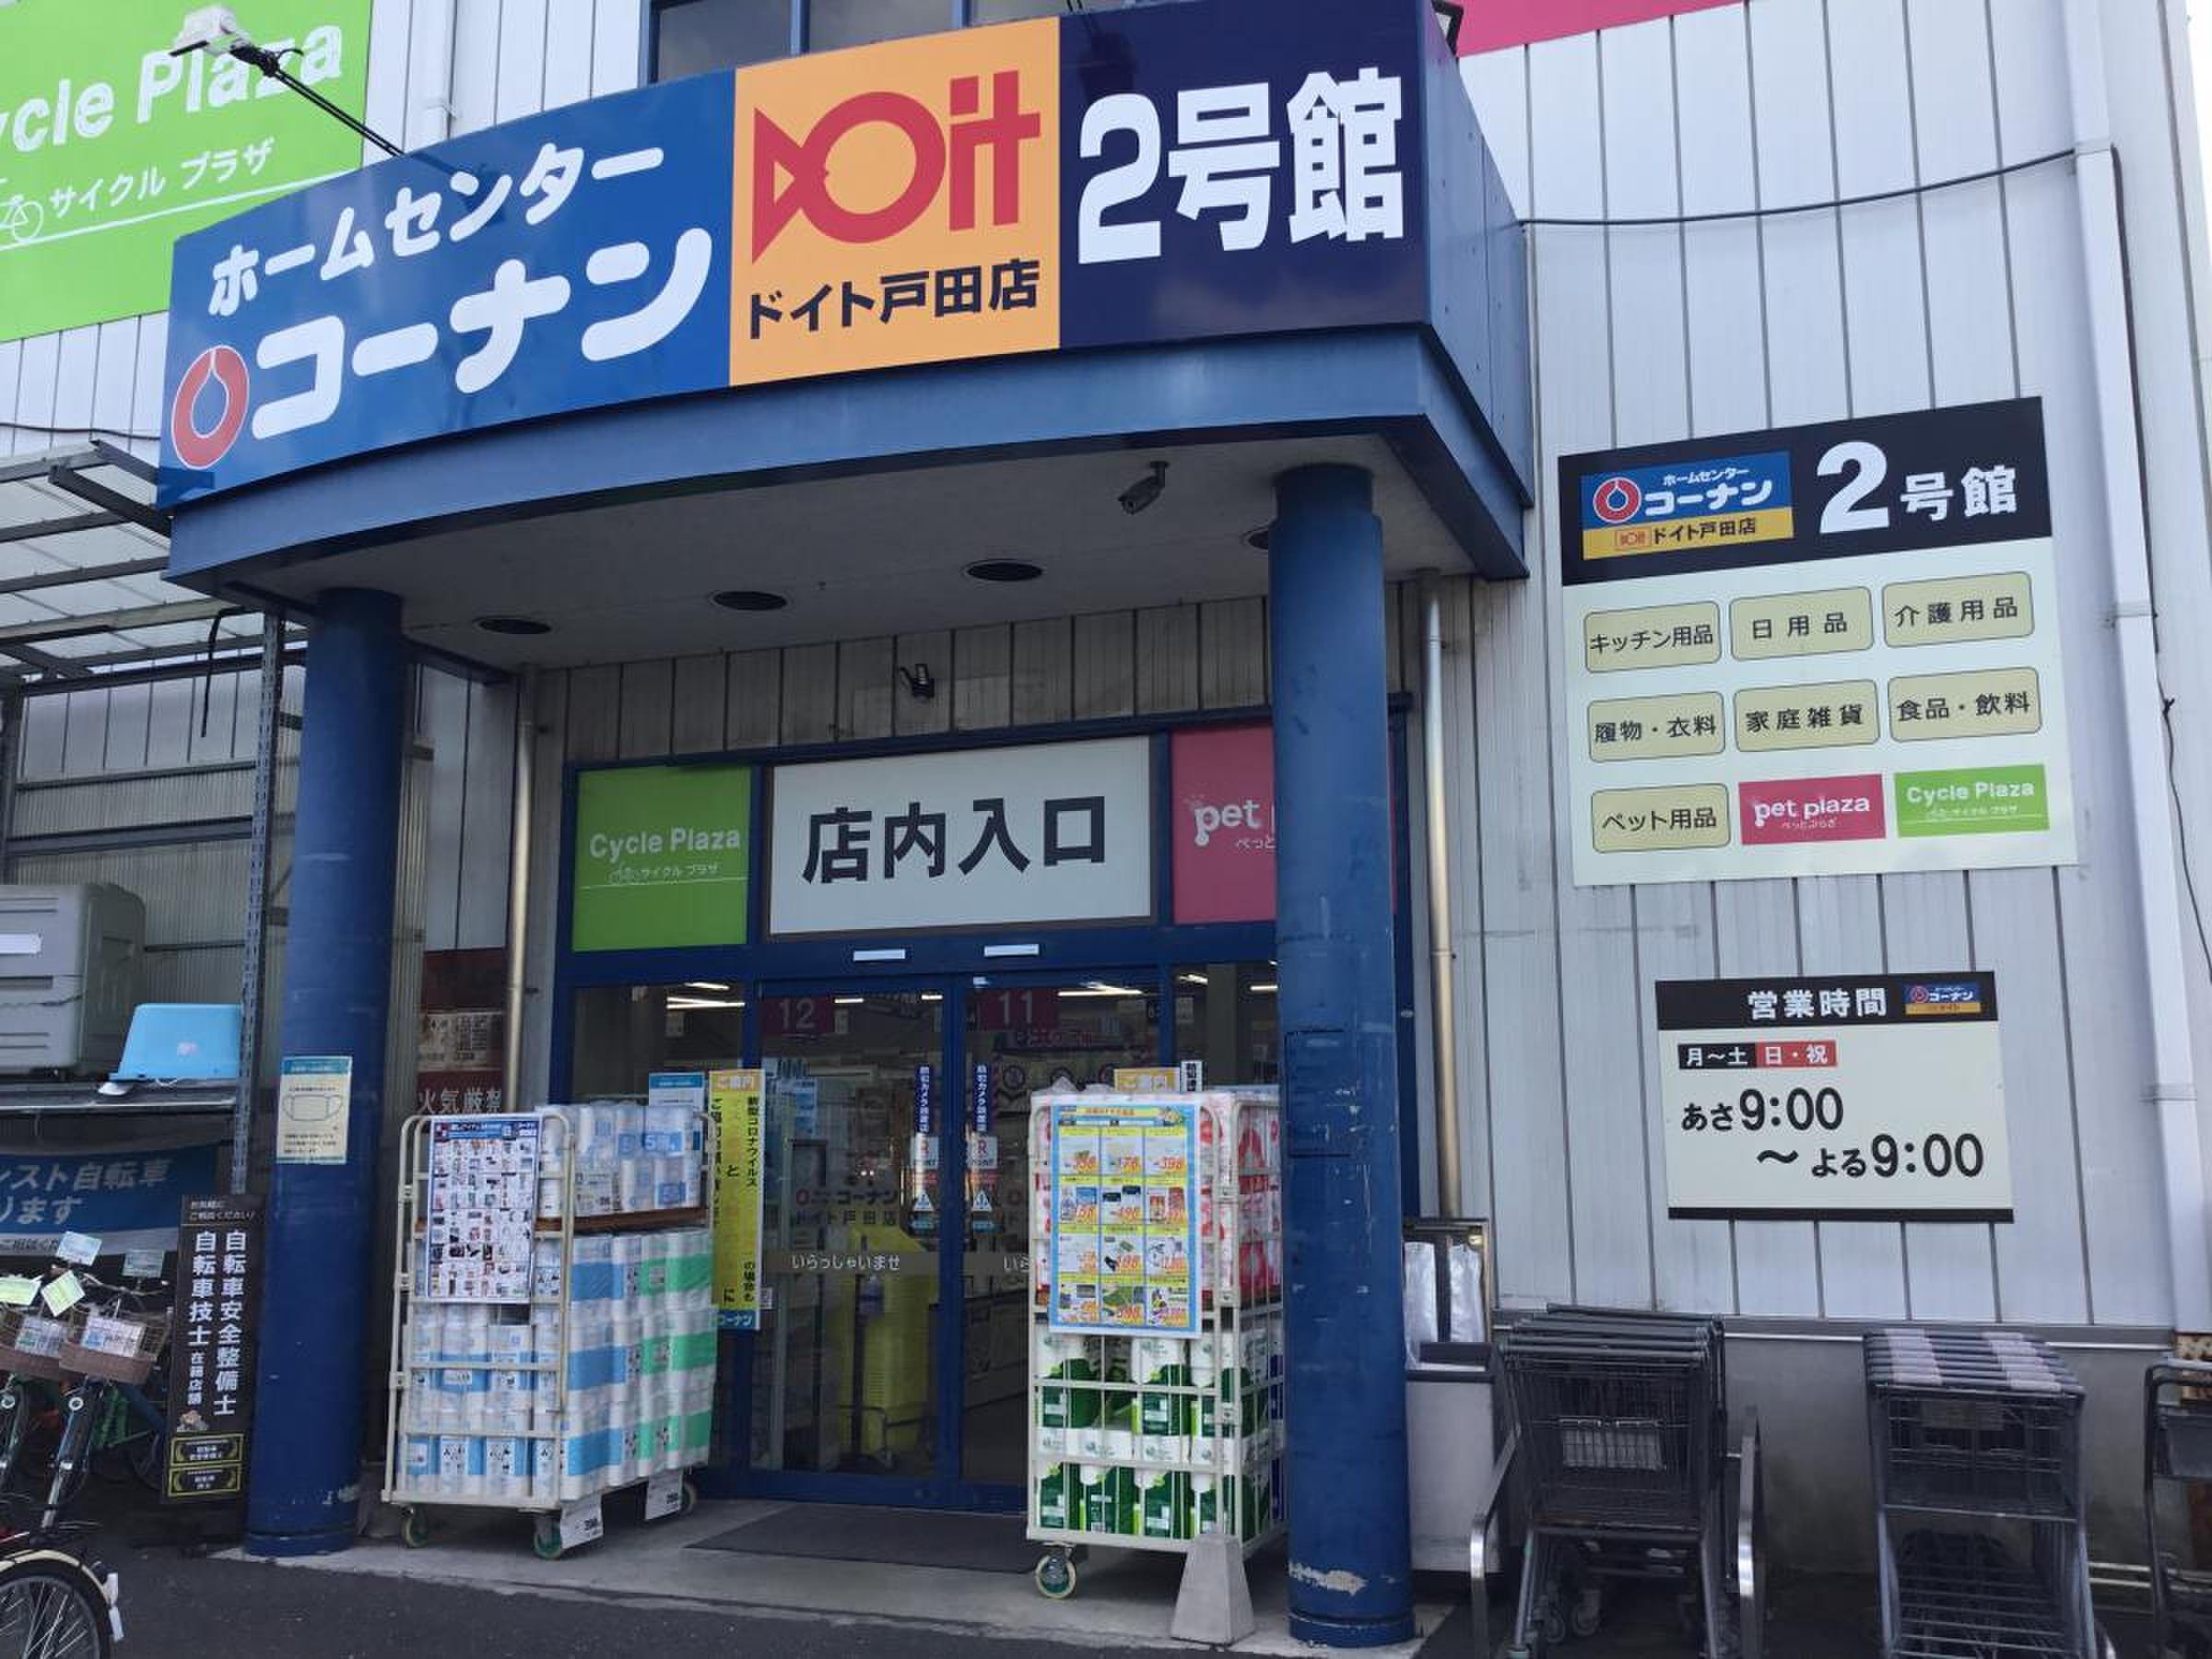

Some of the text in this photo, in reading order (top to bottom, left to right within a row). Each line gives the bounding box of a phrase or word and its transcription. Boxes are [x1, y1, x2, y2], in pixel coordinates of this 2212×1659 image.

[0, 78, 114, 152] cle
[50, 137, 275, 218] サイクル プラザ
[1078, 67, 1404, 265] 2号館
[208, 144, 664, 317] ホームセンター
[750, 258, 1041, 340] ドイト戸田店
[251, 228, 712, 440] コーナン
[1663, 467, 1749, 486] ホームセンター
[1816, 441, 2017, 535] 2号館
[1644, 479, 1773, 516] コーナン
[1653, 517, 1756, 544] ドイト戸田店
[1751, 612, 1848, 640] 日用品
[1894, 596, 2018, 629] 介護用品
[1590, 625, 1713, 654] キッチン用品
[1746, 703, 1864, 733] 家庭雑貨
[1896, 692, 2030, 723] 食品・飲料
[1594, 714, 1716, 743] 履物・衣料
[1907, 782, 2035, 806] Cycle Plaza
[1194, 799, 1261, 847] pet
[1601, 807, 1717, 832] ペット用品
[1754, 796, 1871, 827] pet plaza
[590, 827, 740, 864] Cycle Plaza
[803, 795, 1106, 885] 店内入口
[999, 994, 1033, 1025] 11
[1747, 987, 1888, 1020] 営業時間
[1929, 992, 1974, 1002] コーナン
[778, 1000, 816, 1030] 12
[1764, 1044, 1830, 1065] 日・祝
[793, 1253, 900, 1271] いらっしゃいませ
[189, 1230, 217, 1347] 自転車技士
[214, 1229, 247, 1416] 自転車安全整備士
